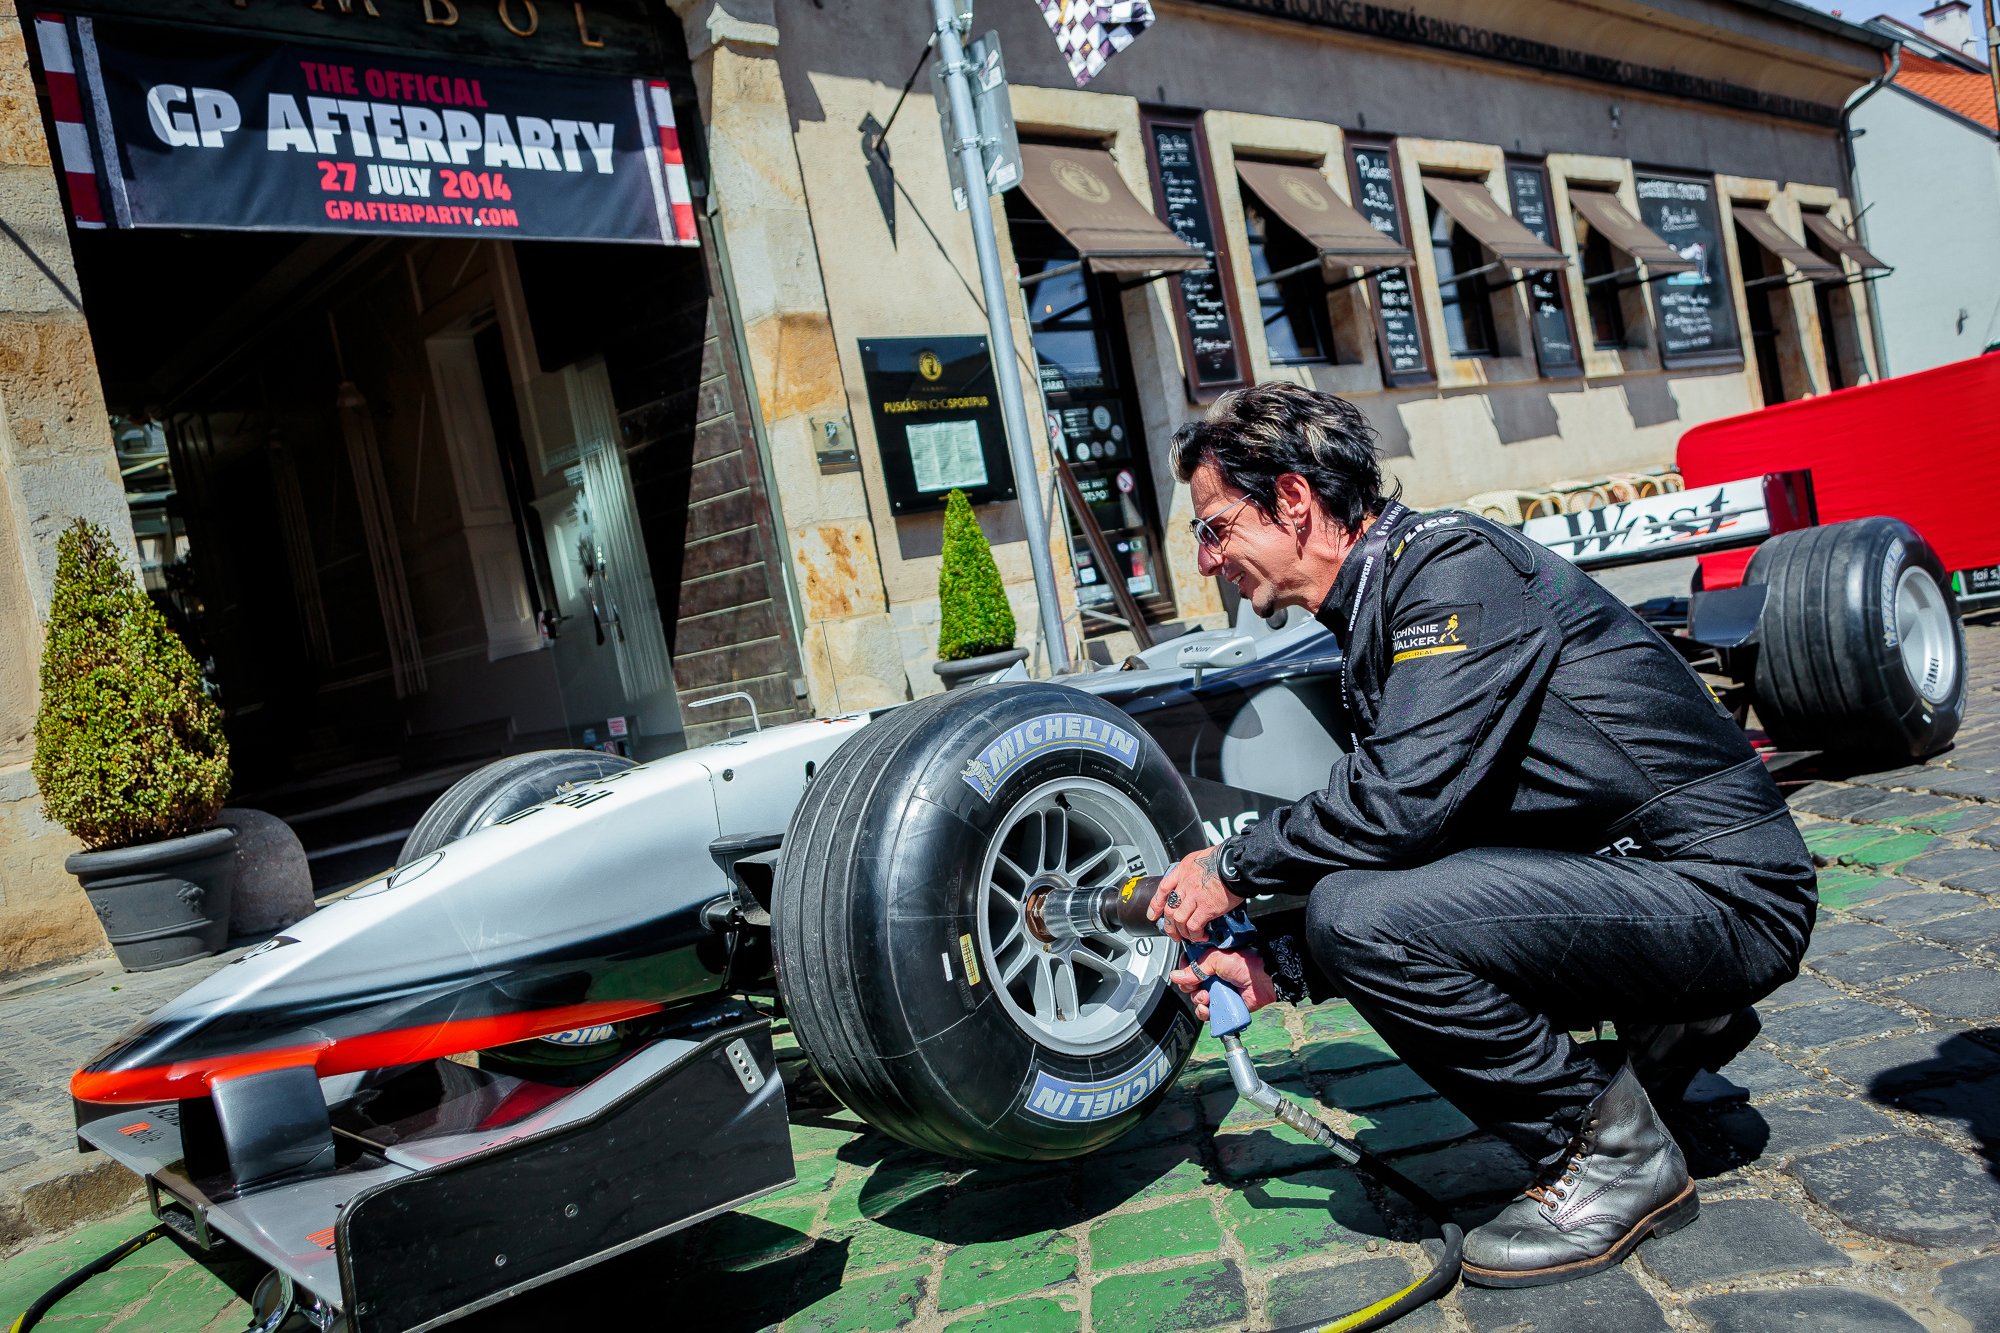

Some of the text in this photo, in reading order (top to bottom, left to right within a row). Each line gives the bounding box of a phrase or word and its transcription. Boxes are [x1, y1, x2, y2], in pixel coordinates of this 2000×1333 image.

[299, 62, 488, 108] THE OFFICIAL
[147, 84, 615, 175] GP AFTERPARTY
[317, 160, 512, 201] 27 JULY 2014
[325, 200, 519, 228] GPAFTERPARTY.COM
[988, 717, 1135, 776] MICHELIN
[1033, 1040, 1178, 1118] MICHELIN
